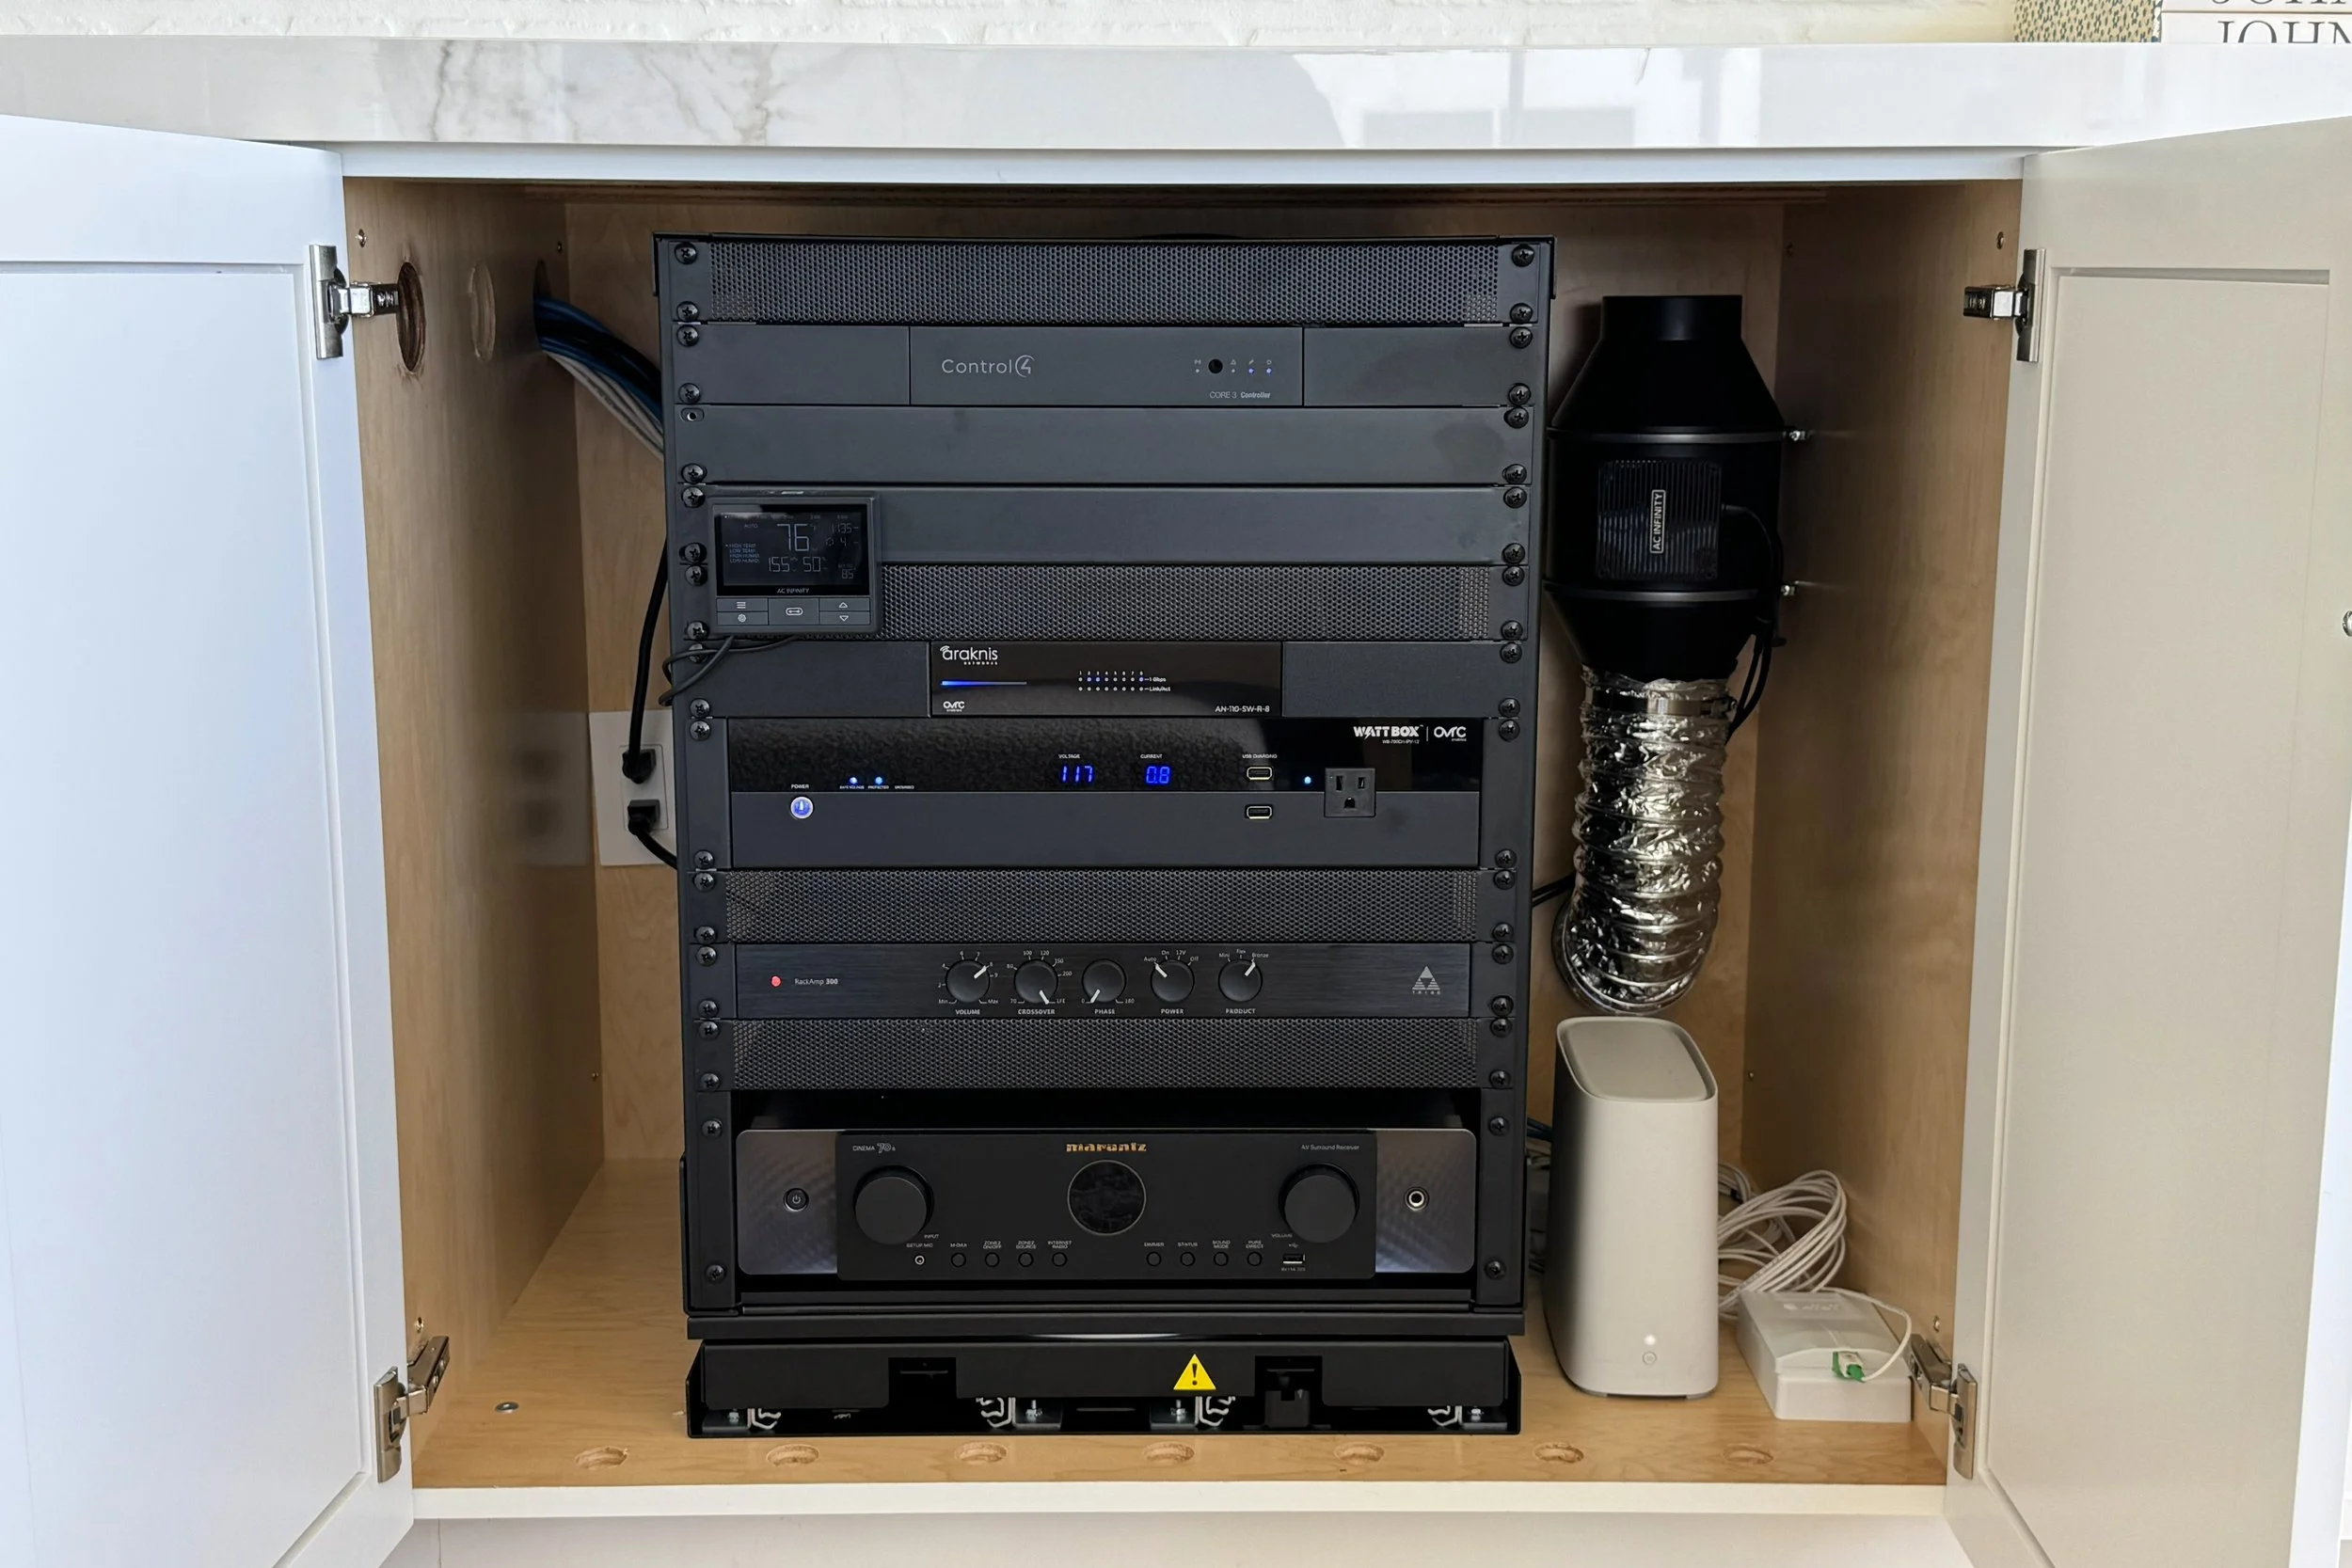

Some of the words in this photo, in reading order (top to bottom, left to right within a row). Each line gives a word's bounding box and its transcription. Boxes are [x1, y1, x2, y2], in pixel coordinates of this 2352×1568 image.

[1653, 493, 1663, 535] INFINITY
[776, 523, 809, 551] 76
[1653, 536, 1661, 550] AC
[803, 556, 821, 572] 50
[940, 646, 998, 660] araknis
[1062, 765, 1093, 783] 117
[1066, 1142, 1147, 1152] marantz
